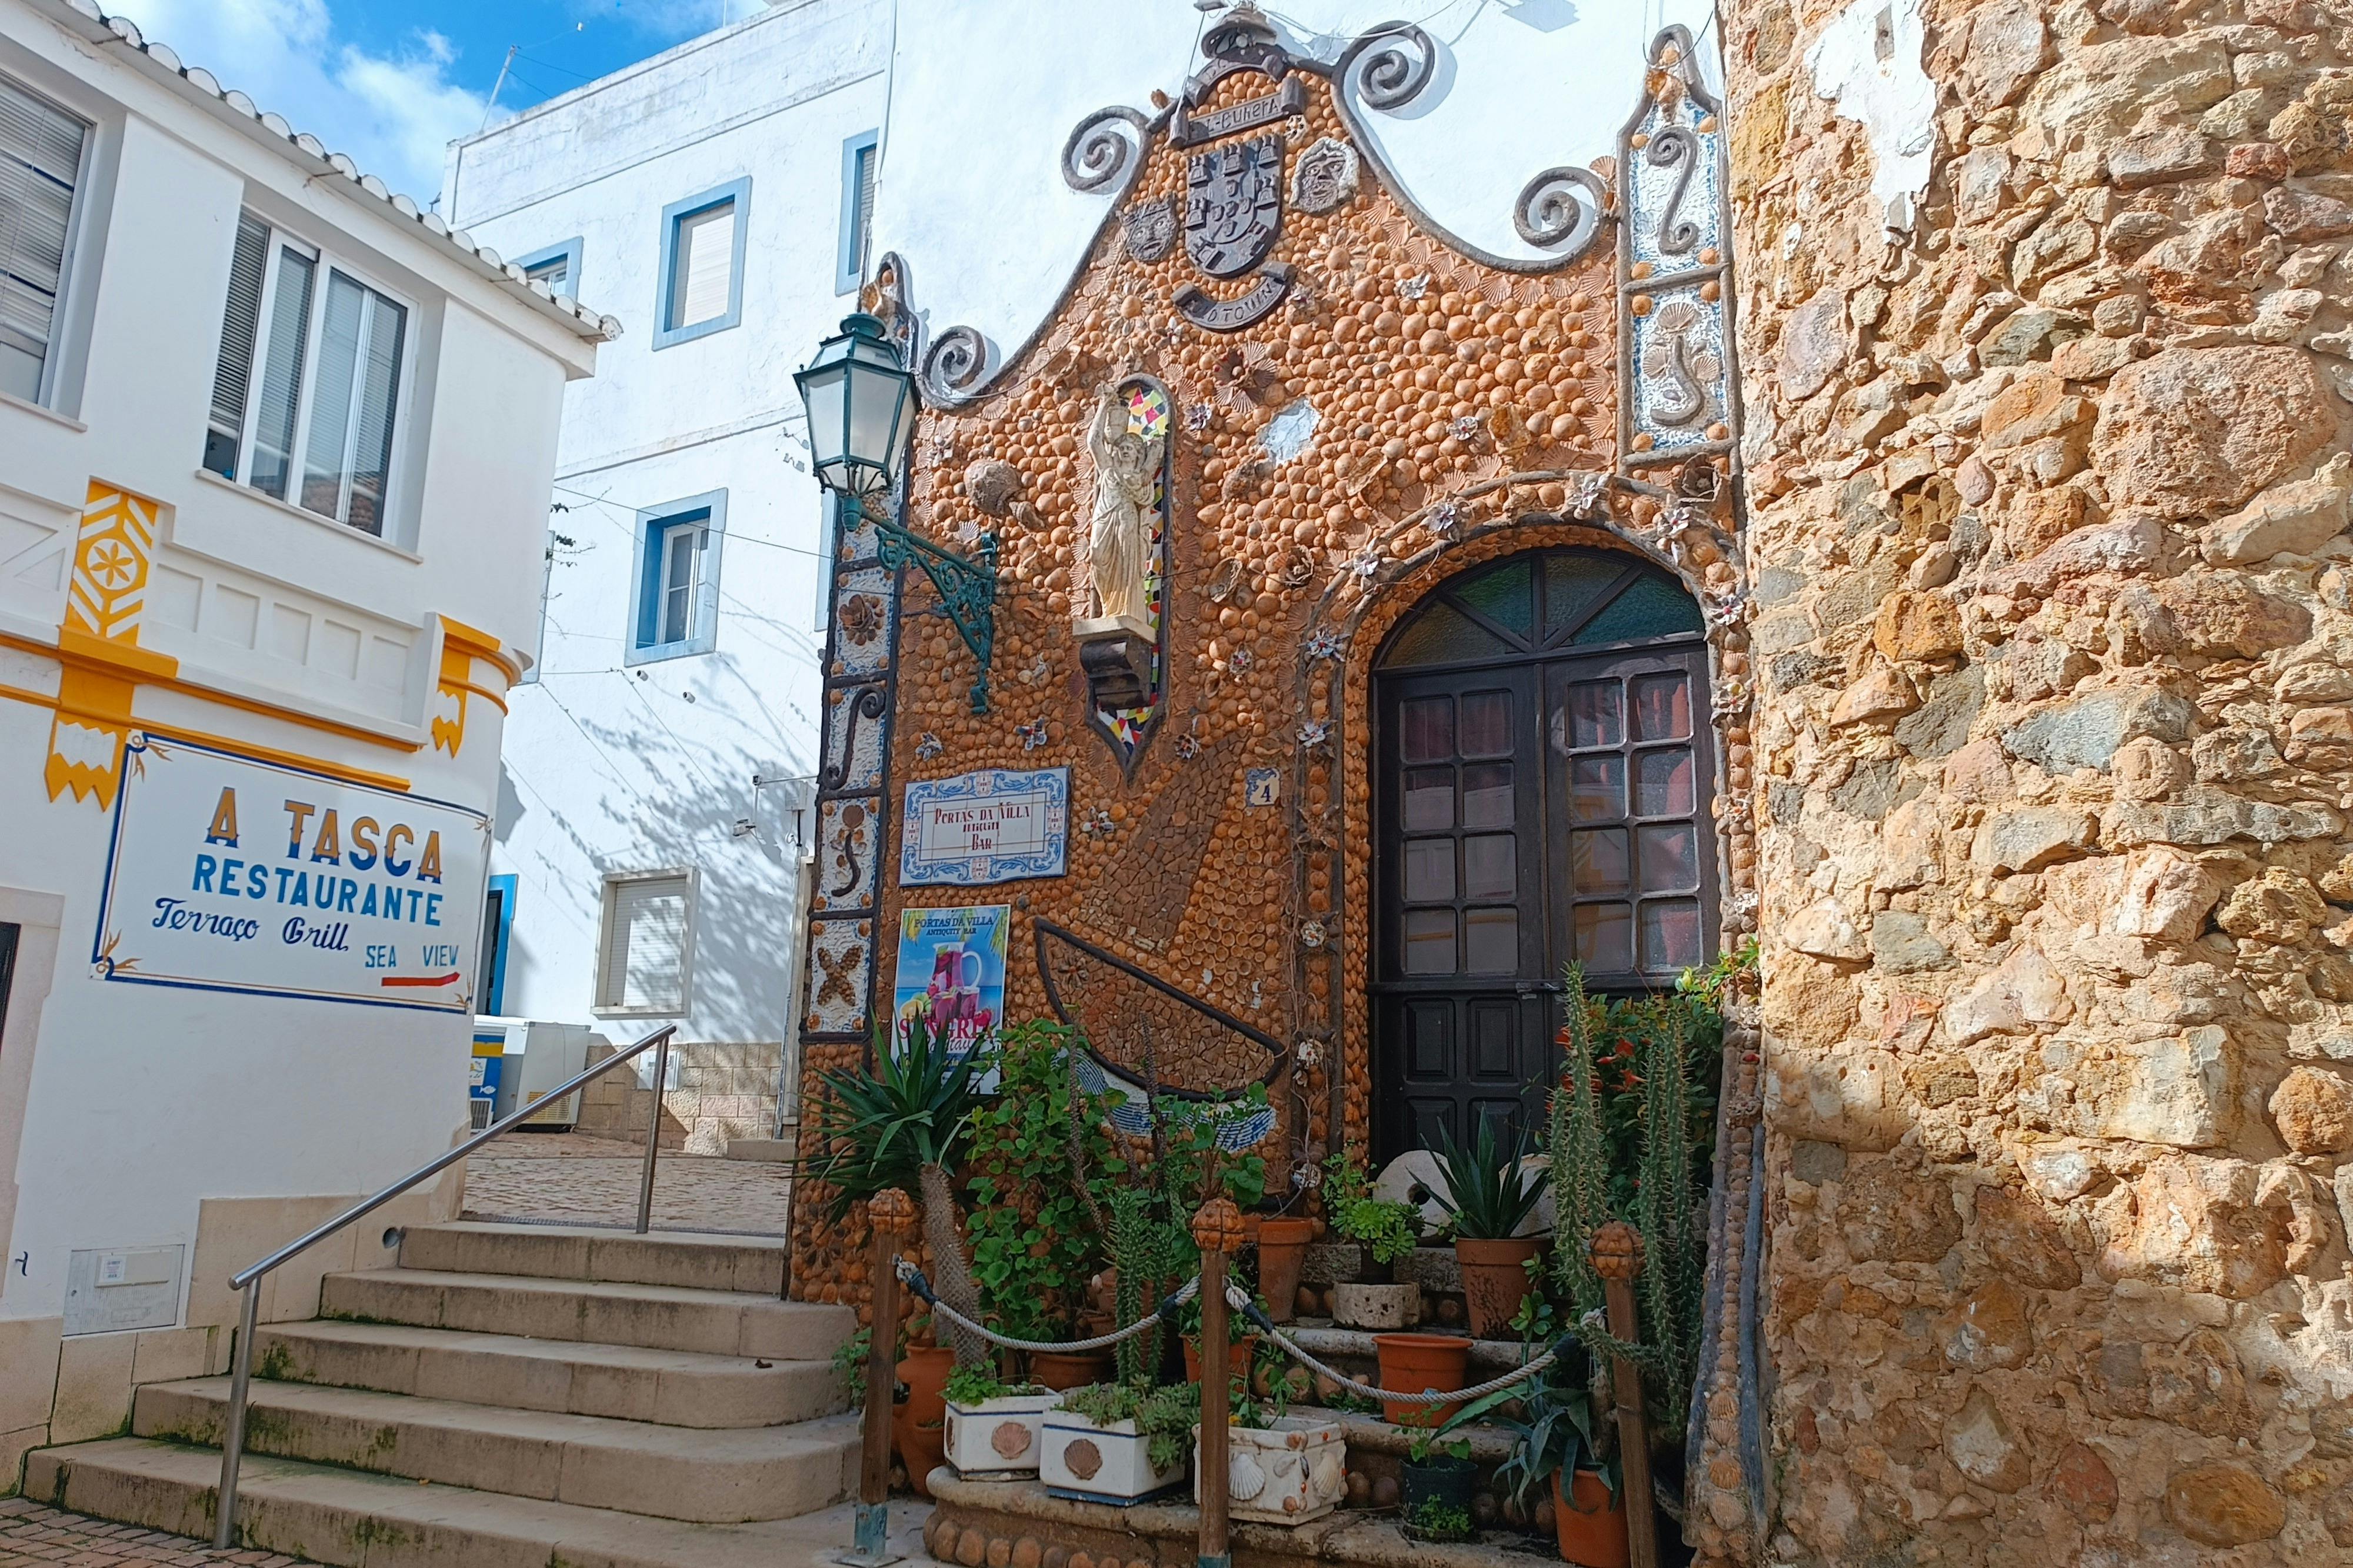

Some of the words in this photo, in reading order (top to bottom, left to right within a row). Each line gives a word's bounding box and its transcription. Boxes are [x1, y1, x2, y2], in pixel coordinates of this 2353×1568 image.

[1260, 783, 1272, 803] 4
[205, 786, 239, 849] A
[284, 799, 442, 885] TASCA
[192, 853, 443, 927] RESTAURANTE
[152, 898, 261, 942] Terraço
[282, 916, 350, 952] Grill
[915, 918, 951, 928] PORTAS
[952, 918, 965, 927] DA
[968, 916, 994, 926] VILLA
[926, 928, 961, 936] ANTIQUITY
[964, 927, 977, 935] BAR
[365, 945, 397, 968] SEA
[423, 945, 459, 968] VIEW
